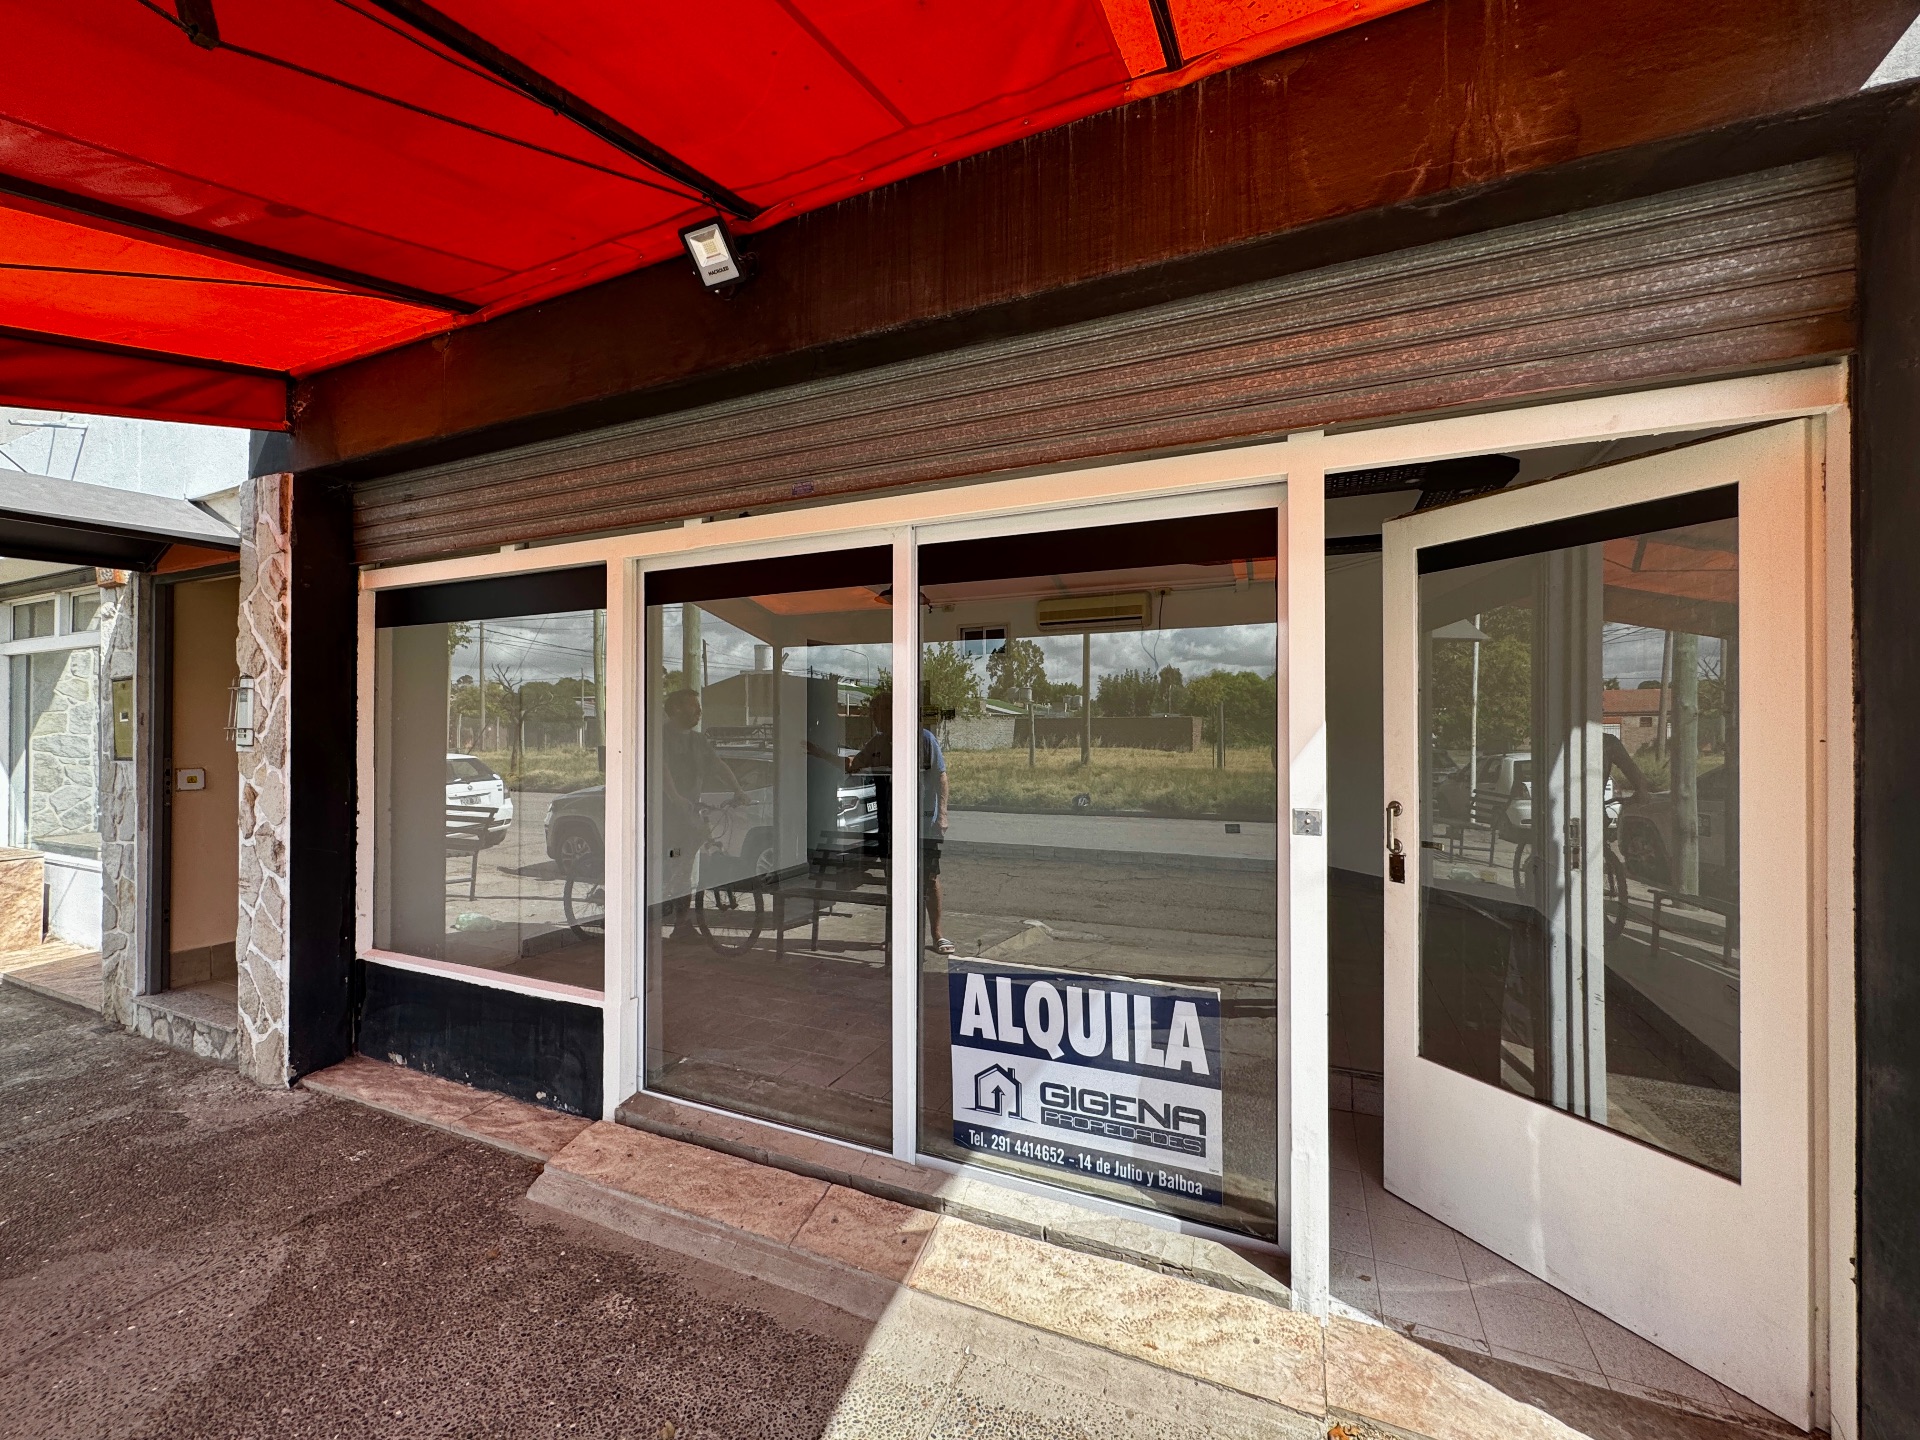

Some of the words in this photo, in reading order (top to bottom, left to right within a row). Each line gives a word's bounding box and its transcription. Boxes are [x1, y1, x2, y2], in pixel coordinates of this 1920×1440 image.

[959, 972, 1210, 1076] ALQUILA
[1039, 1081, 1207, 1137] GIGENA
[968, 1129, 988, 1148] Tel.
[991, 1134, 1011, 1153] 291
[1014, 1140, 1065, 1165] 4414652
[1077, 1153, 1092, 1171] 14
[1096, 1157, 1111, 1174] de
[1113, 1159, 1143, 1182] Julio
[1146, 1171, 1154, 1187] y
[1158, 1170, 1204, 1196] Balboa
